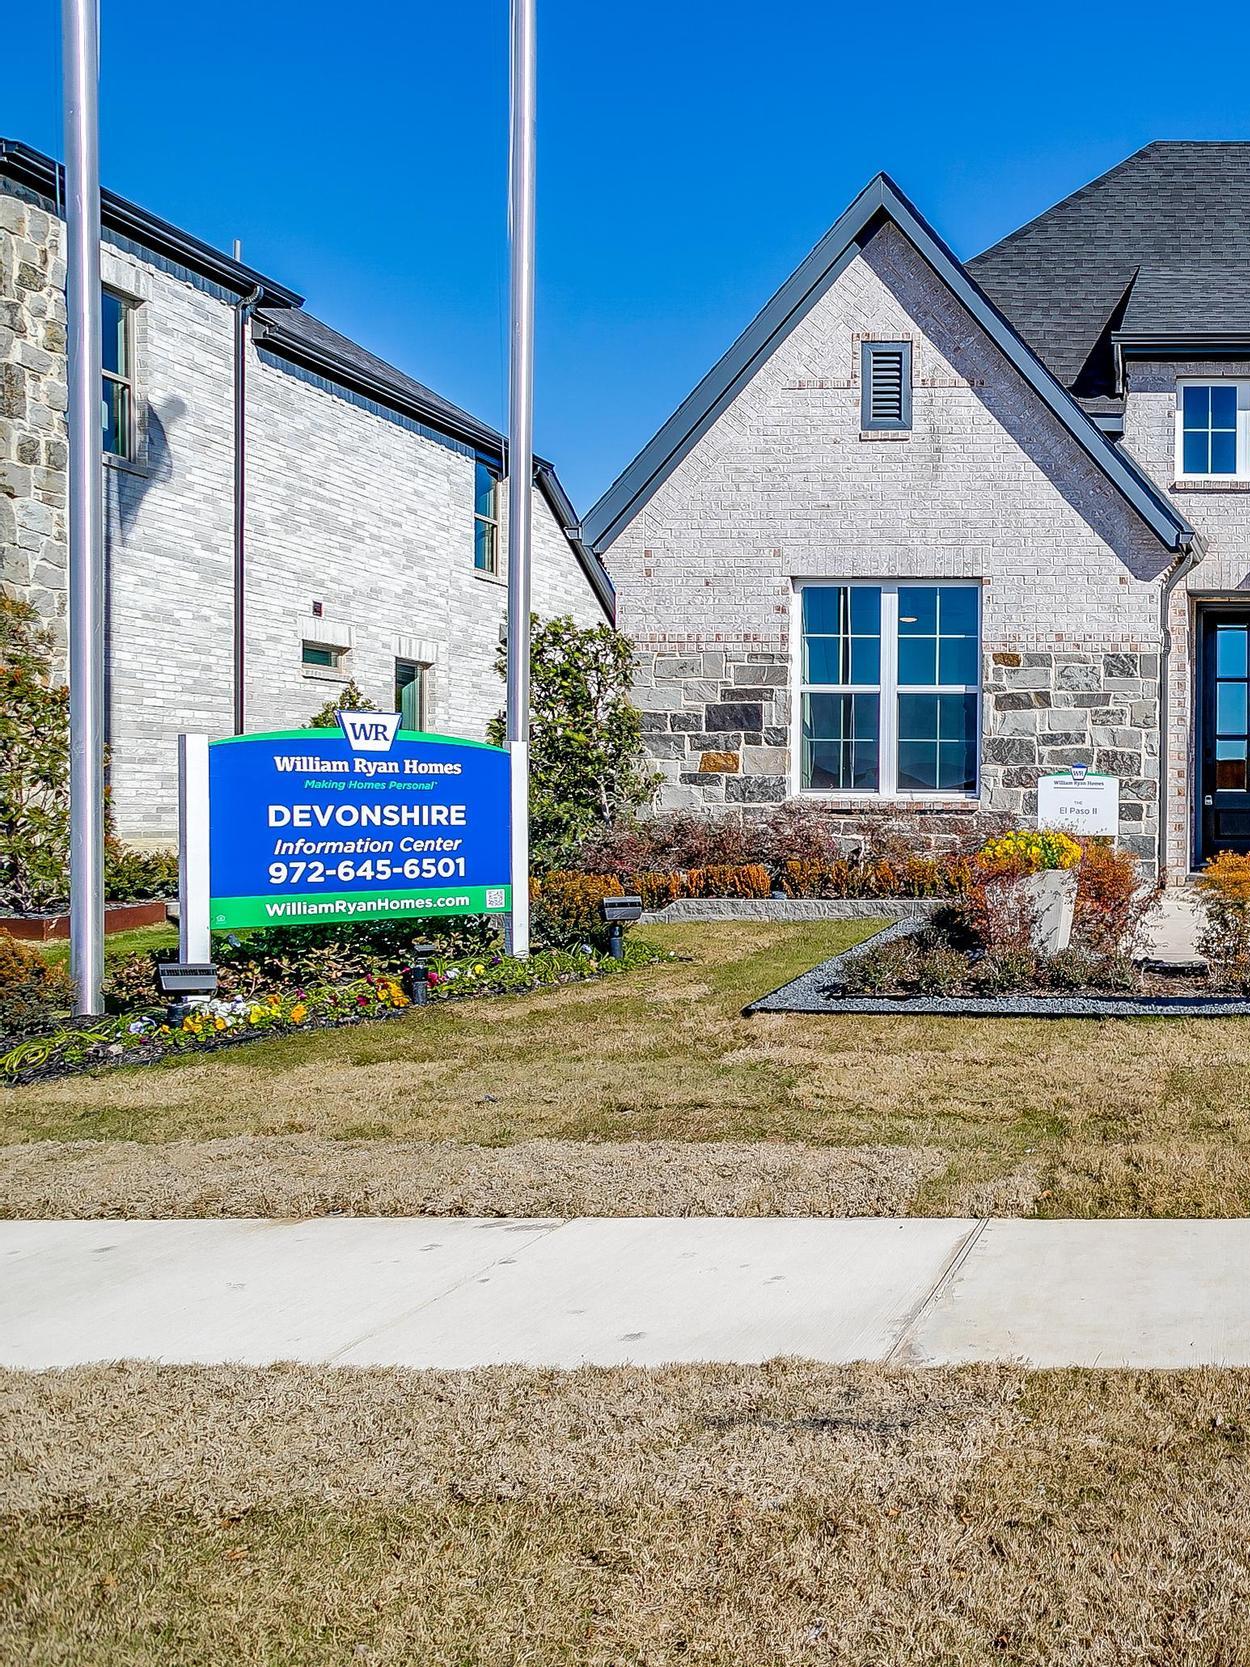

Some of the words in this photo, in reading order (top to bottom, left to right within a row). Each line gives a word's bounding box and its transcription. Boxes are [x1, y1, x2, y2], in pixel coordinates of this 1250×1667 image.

[350, 722, 389, 742] WR
[273, 756, 350, 773] William
[353, 757, 400, 777] Ryan
[403, 759, 462, 775] Homes
[304, 780, 346, 791] Making
[349, 780, 386, 790] Homes
[268, 804, 467, 828] DEVONSHIRE
[1059, 806, 1068, 815] El
[1069, 807, 1090, 815] Paso
[1092, 807, 1098, 815] II
[274, 837, 394, 856] Information
[399, 836, 463, 852] Center
[268, 856, 466, 885] 972-645-6501
[265, 895, 470, 917] WilliamRyanHomes.com
